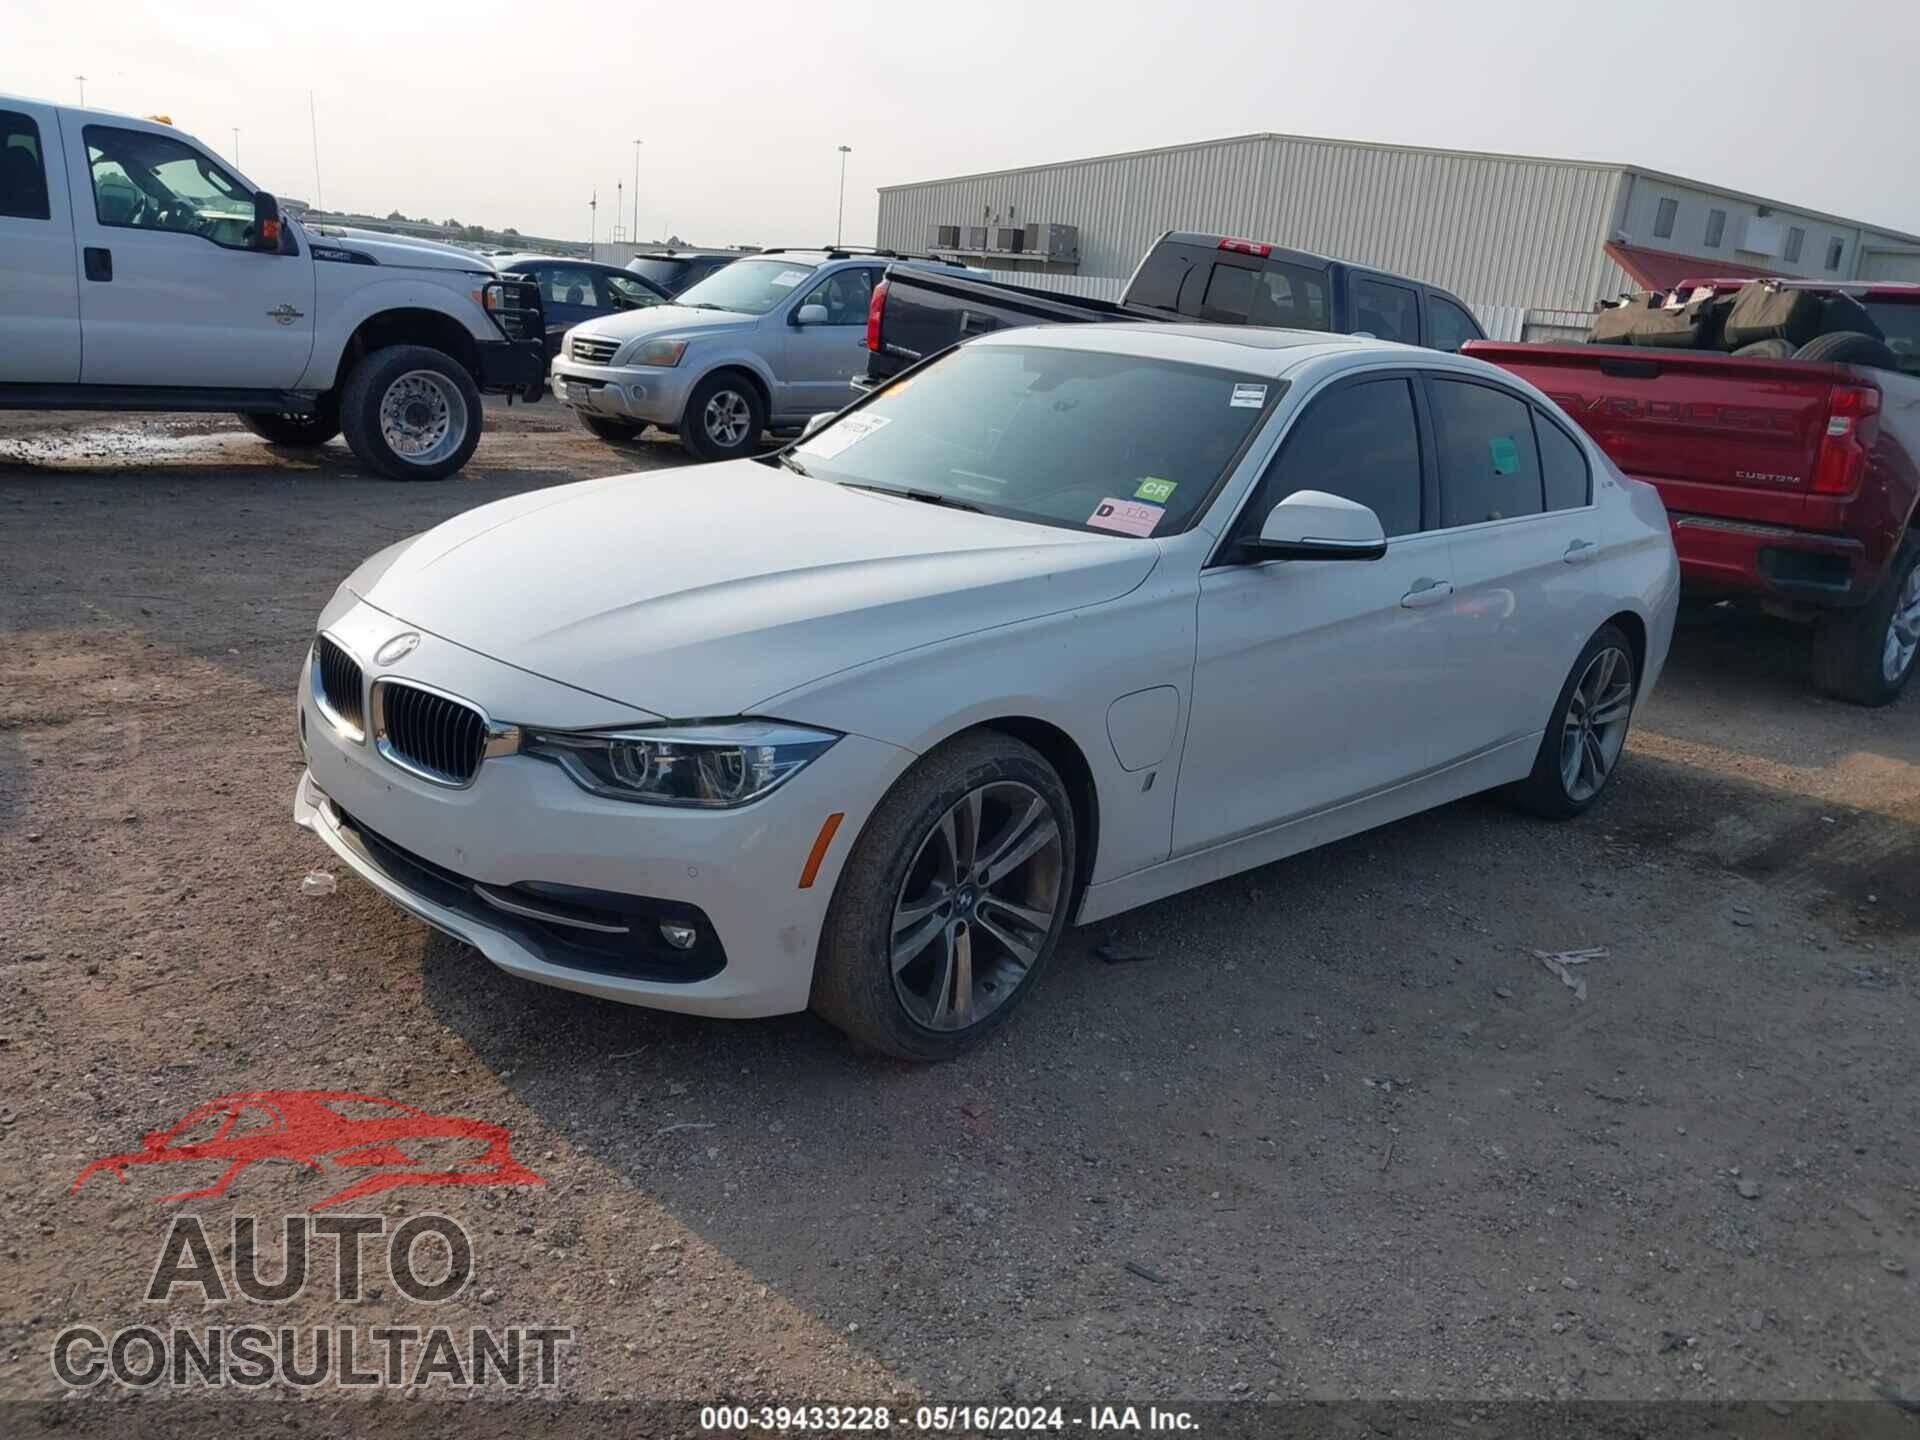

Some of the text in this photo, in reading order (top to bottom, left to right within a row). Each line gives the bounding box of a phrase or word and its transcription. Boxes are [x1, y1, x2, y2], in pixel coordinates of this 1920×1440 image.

[1736, 470, 1800, 483] CUSTOM
[1142, 482, 1169, 498] CR
[1096, 503, 1114, 517] D
